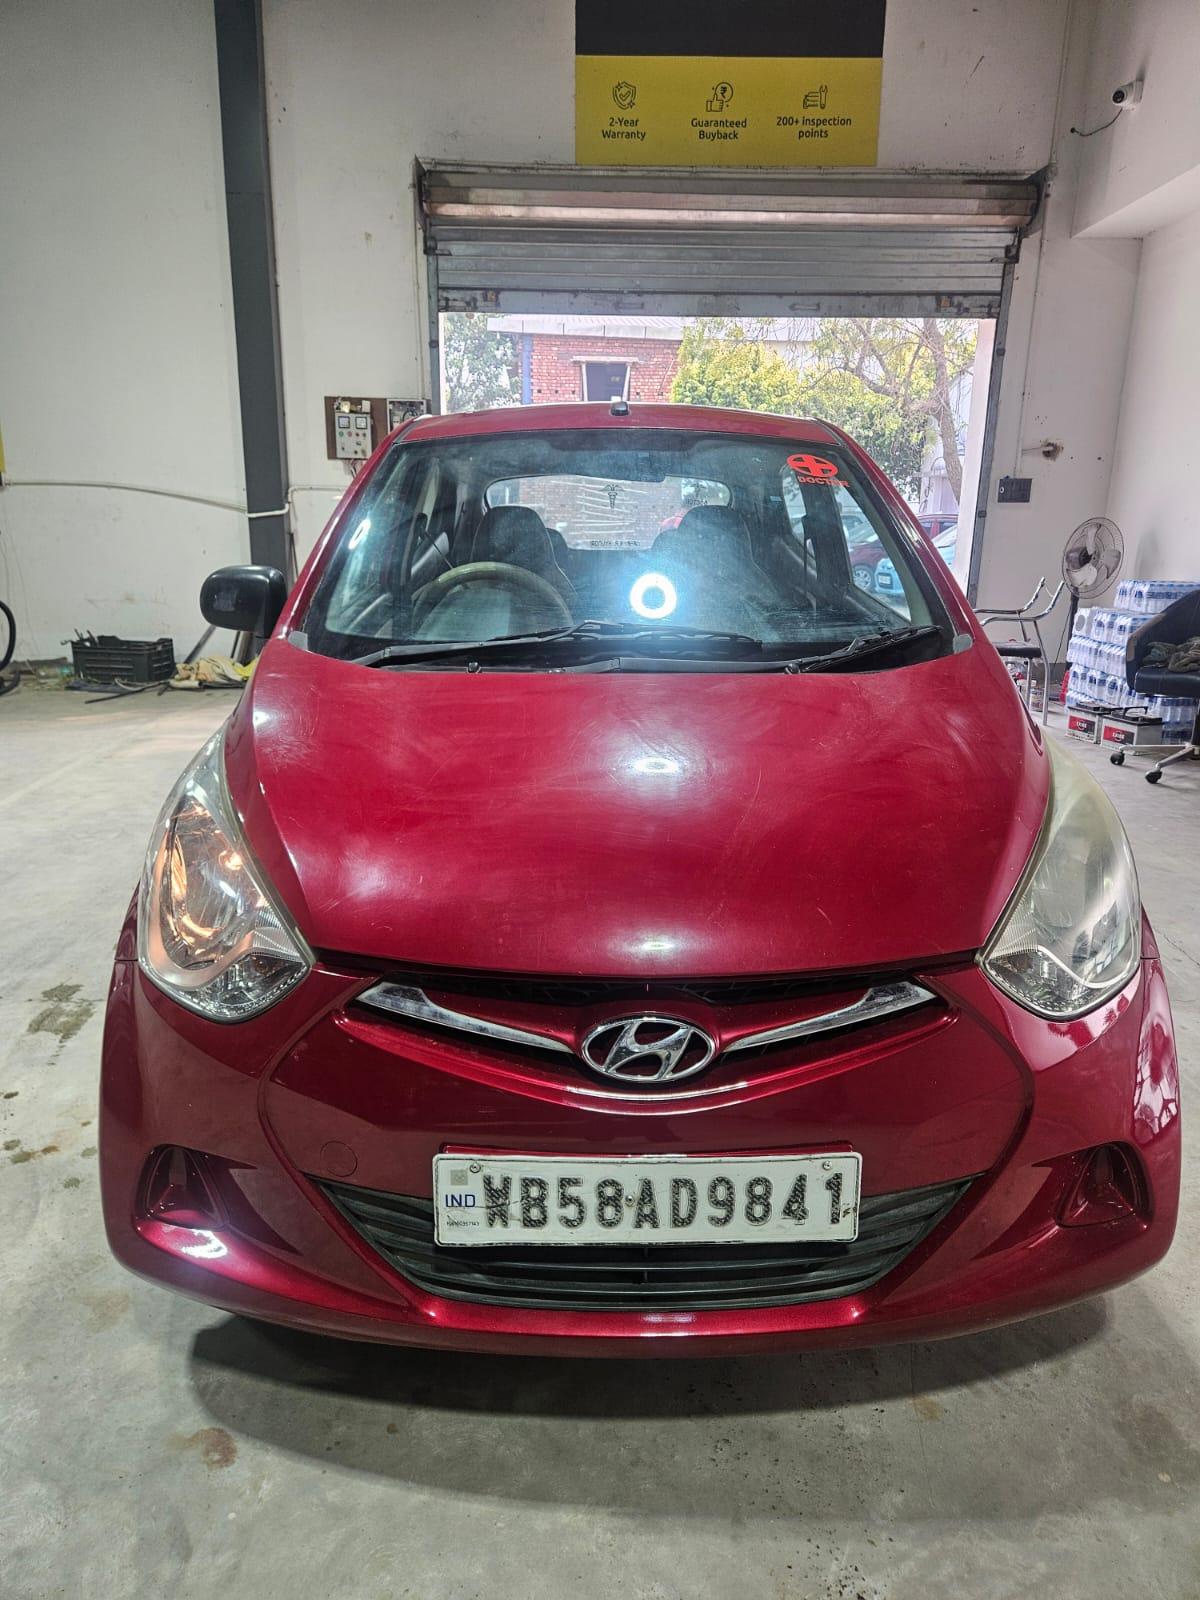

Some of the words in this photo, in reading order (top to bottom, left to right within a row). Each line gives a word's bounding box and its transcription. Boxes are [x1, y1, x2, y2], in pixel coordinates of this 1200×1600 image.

[608, 117, 639, 127] 2-Year
[690, 118, 747, 128] Guaranteed
[776, 116, 799, 127] 200+
[802, 116, 852, 128] inspection
[602, 129, 646, 141] Warranty
[698, 129, 738, 141] Buyback
[798, 128, 828, 139] points
[445, 1193, 476, 1208] IND
[483, 1172, 844, 1230] WB58AD9841
